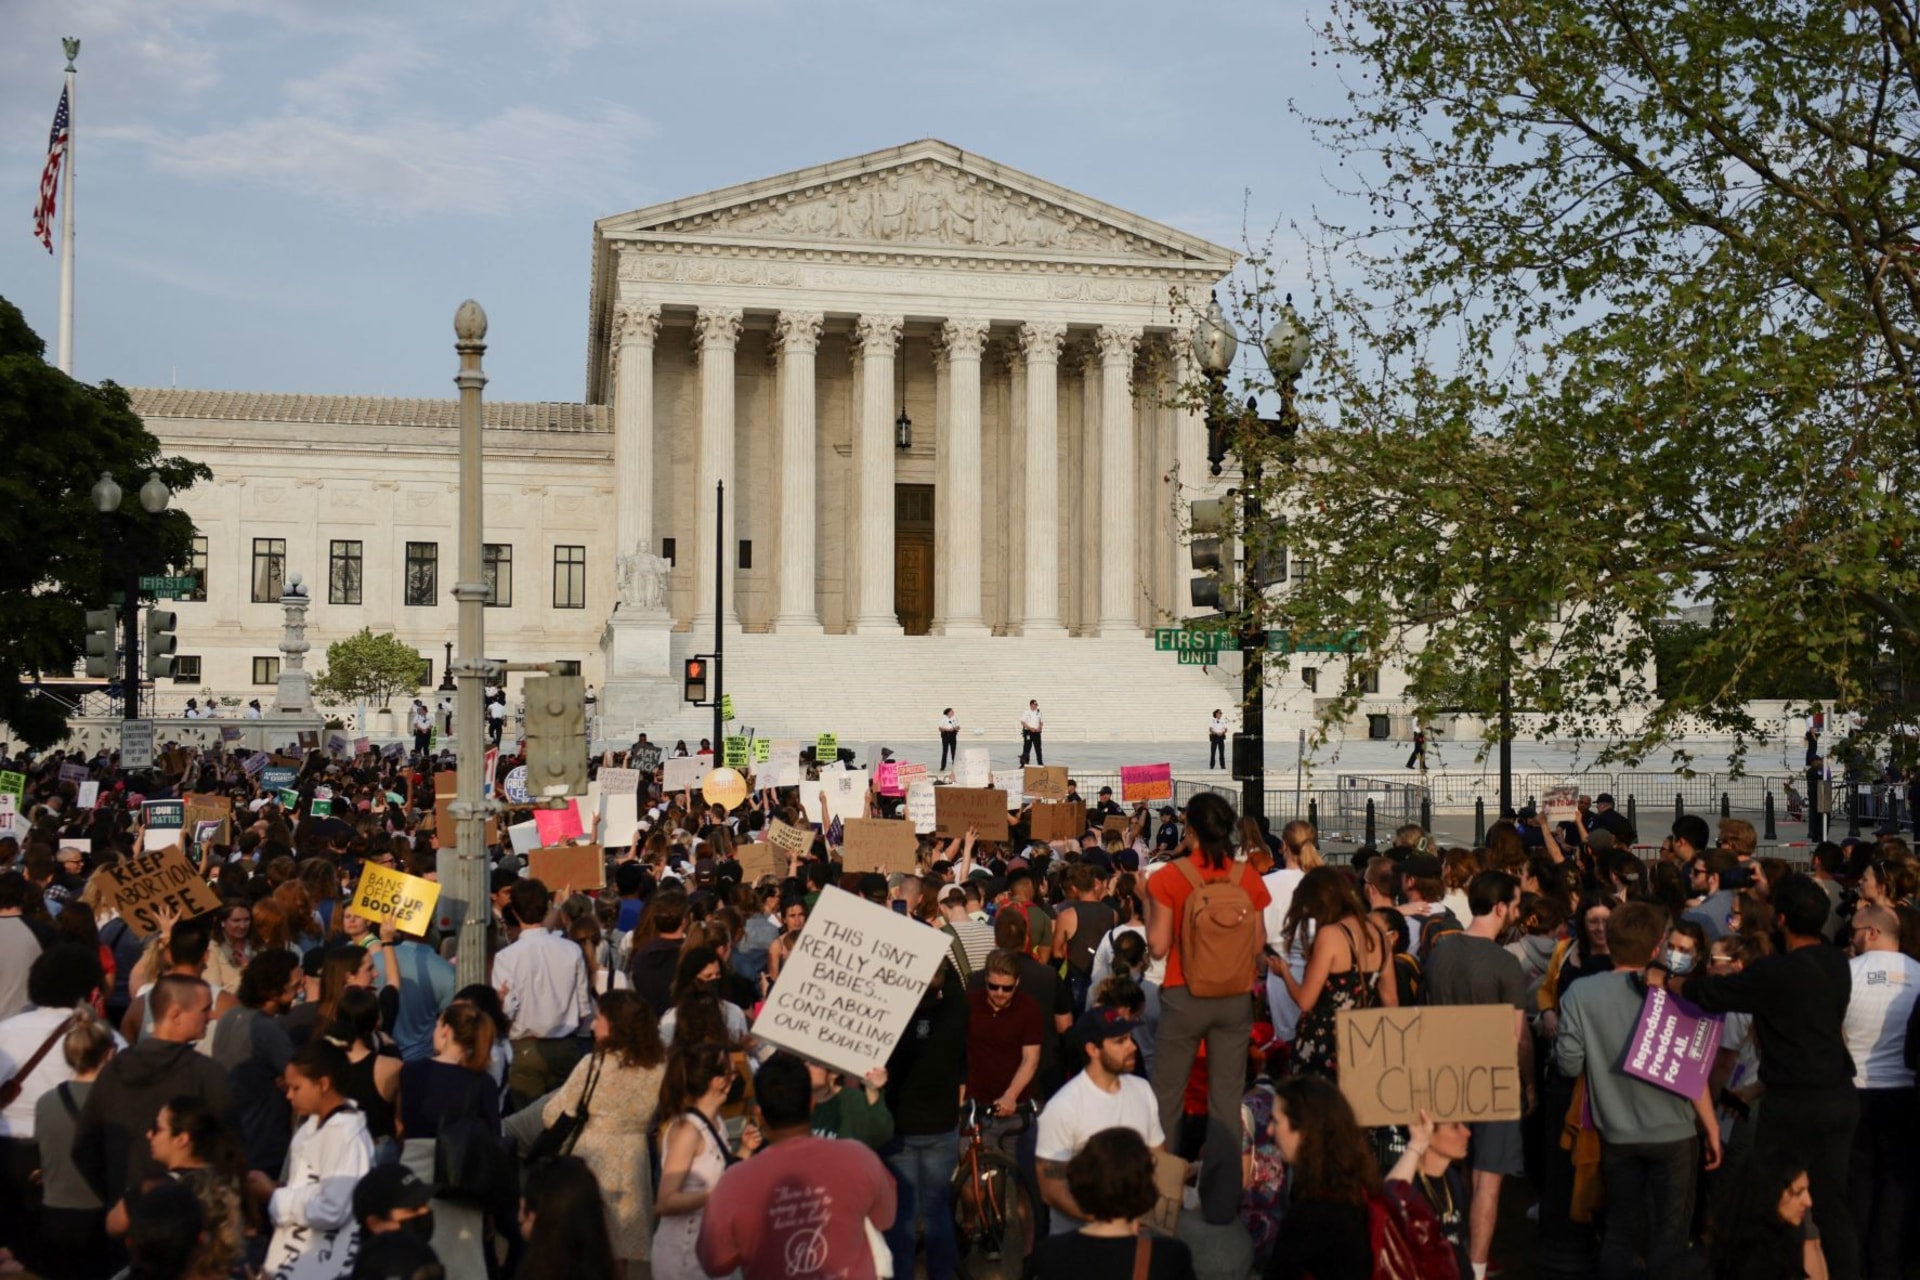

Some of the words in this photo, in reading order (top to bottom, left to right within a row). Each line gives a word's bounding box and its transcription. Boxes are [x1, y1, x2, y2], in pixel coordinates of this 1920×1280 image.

[144, 578, 181, 590] FIRST
[155, 590, 180, 598] UNIT
[1158, 631, 1218, 649] FIRST
[1180, 651, 1216, 664] UNIT
[1221, 640, 1235, 649] NE
[636, 748, 660, 760] AMY
[151, 806, 180, 815] COURTS
[110, 851, 165, 886] KEEP
[114, 861, 197, 911] ABORTION
[368, 872, 404, 894] BANS
[361, 896, 414, 921] BODIES
[364, 884, 390, 900] OFF
[390, 894, 423, 912] OUR
[823, 920, 864, 948] THIS
[872, 939, 918, 969] ISNT
[800, 934, 869, 974] REALLY
[872, 967, 928, 995] ABOUT
[778, 992, 894, 1046] CONTROLLING
[800, 982, 826, 1001] ITS
[832, 996, 892, 1022] ABOUT
[774, 1013, 810, 1034] OUR
[818, 1027, 881, 1060] BODIES!
[1348, 1015, 1421, 1068] MY
[1632, 988, 1667, 1070] Reproductiv
[1648, 1014, 1678, 1077] Freedom
[1664, 1058, 1680, 1084] For
[1674, 1036, 1689, 1058] All.
[1377, 1065, 1515, 1118] CHOICE
